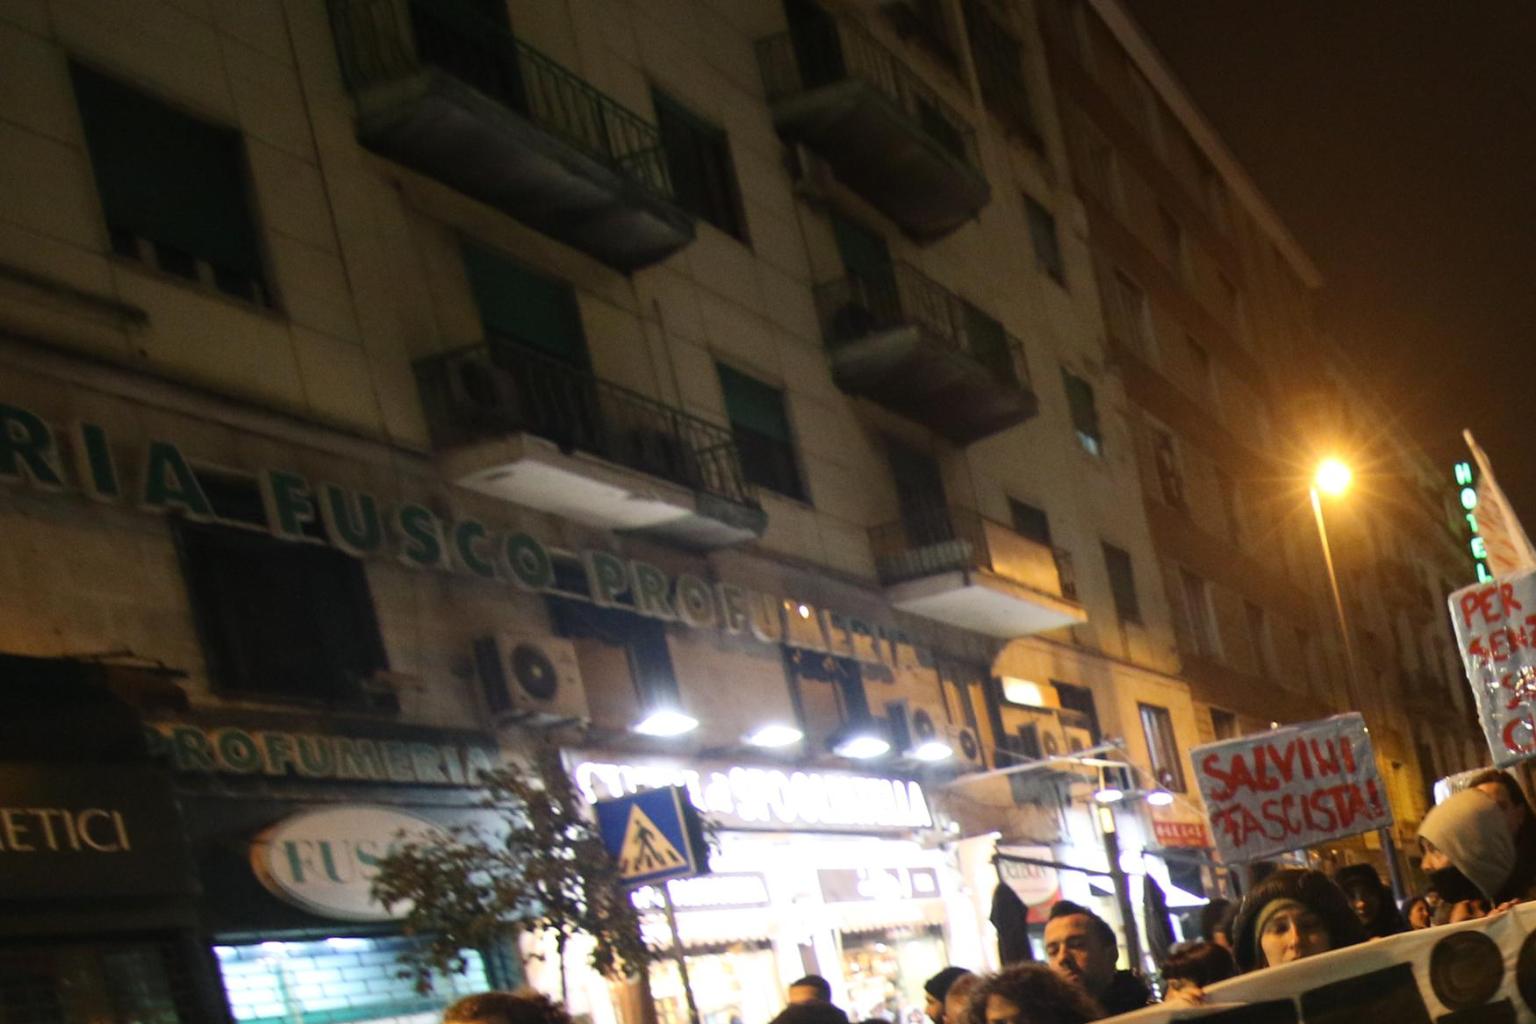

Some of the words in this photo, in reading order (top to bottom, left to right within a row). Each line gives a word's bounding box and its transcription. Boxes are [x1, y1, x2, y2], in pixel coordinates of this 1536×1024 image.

[259, 471, 556, 590] FUSCO
[1454, 461, 1494, 584] HOTEL
[1460, 582, 1522, 629] PER
[1202, 736, 1357, 802] SALVINI
[0, 807, 131, 853] ETICI
[1211, 777, 1385, 849] FASCISTA!
